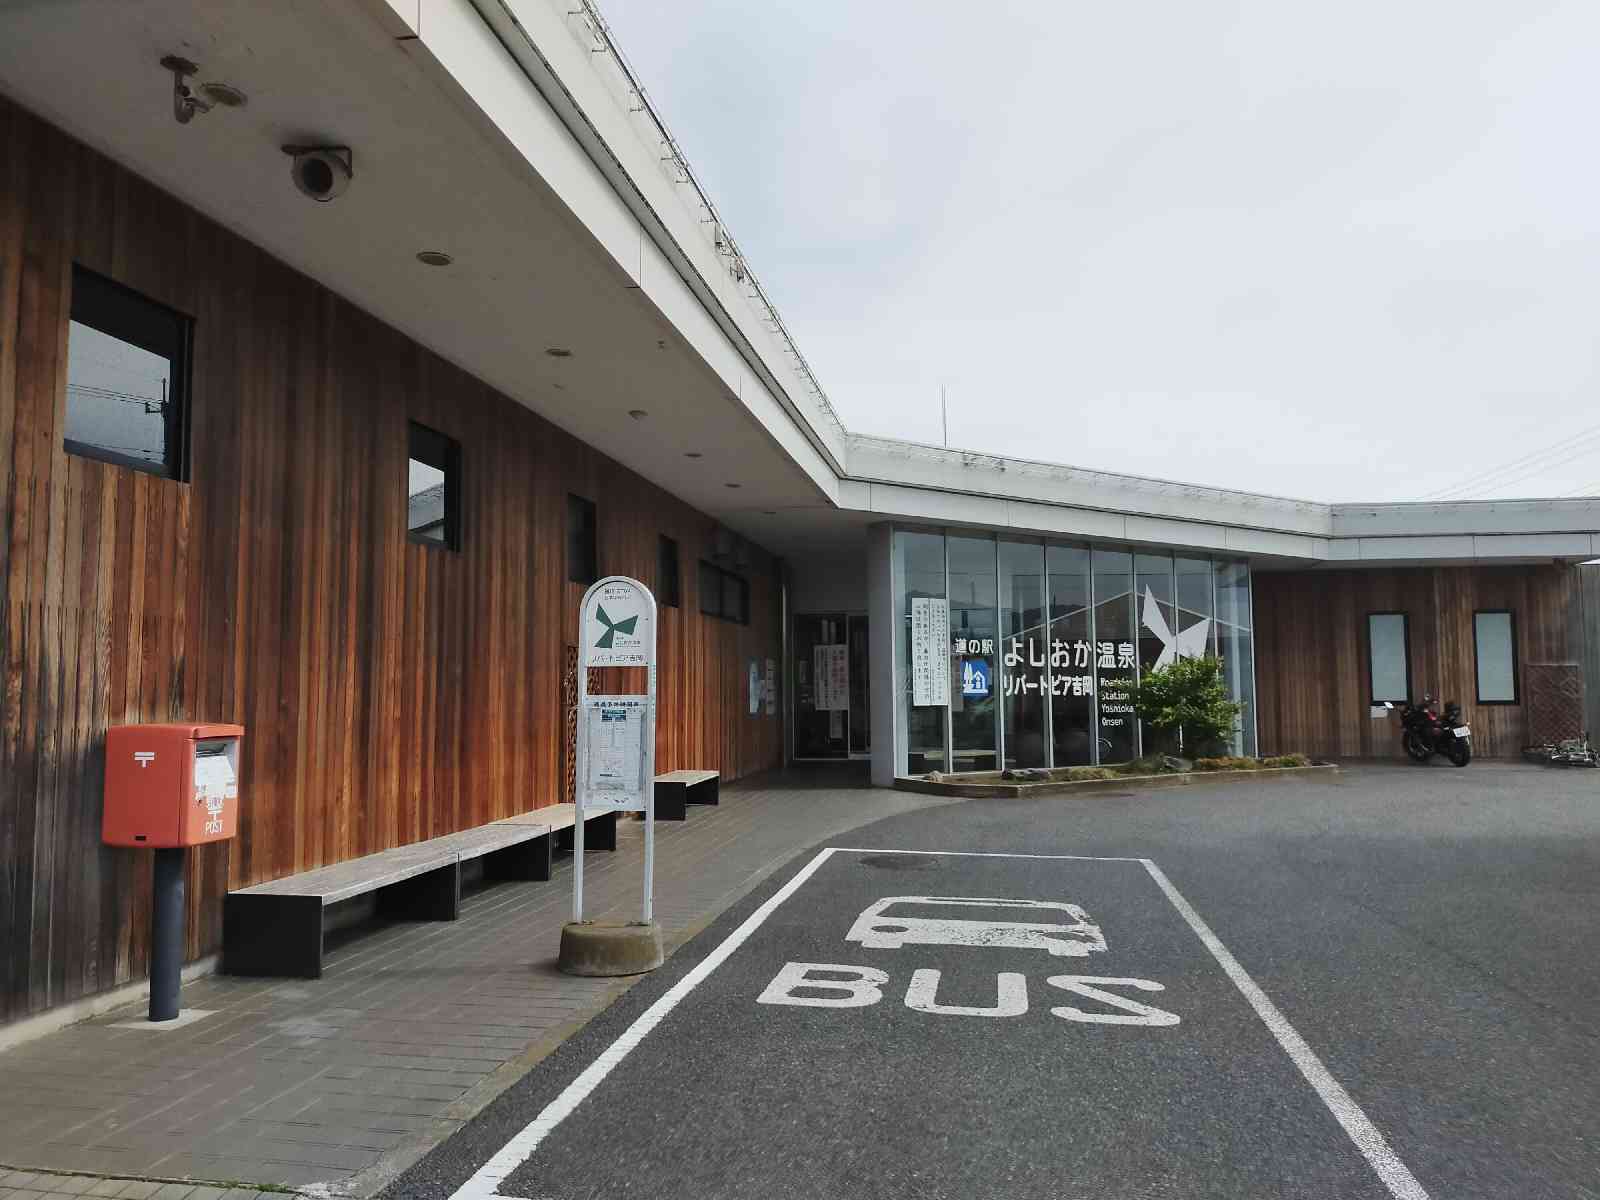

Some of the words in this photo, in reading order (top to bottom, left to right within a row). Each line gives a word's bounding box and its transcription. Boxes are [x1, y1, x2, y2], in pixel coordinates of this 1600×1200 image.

[952, 638, 993, 654] 道の駅
[1004, 637, 1136, 668] よしおか温泉
[1004, 674, 1093, 696] リバートピア吉岡
[1101, 703, 1135, 713] Yoshioka
[1102, 717, 1124, 726] Onsen
[756, 962, 1181, 1027] BUS
